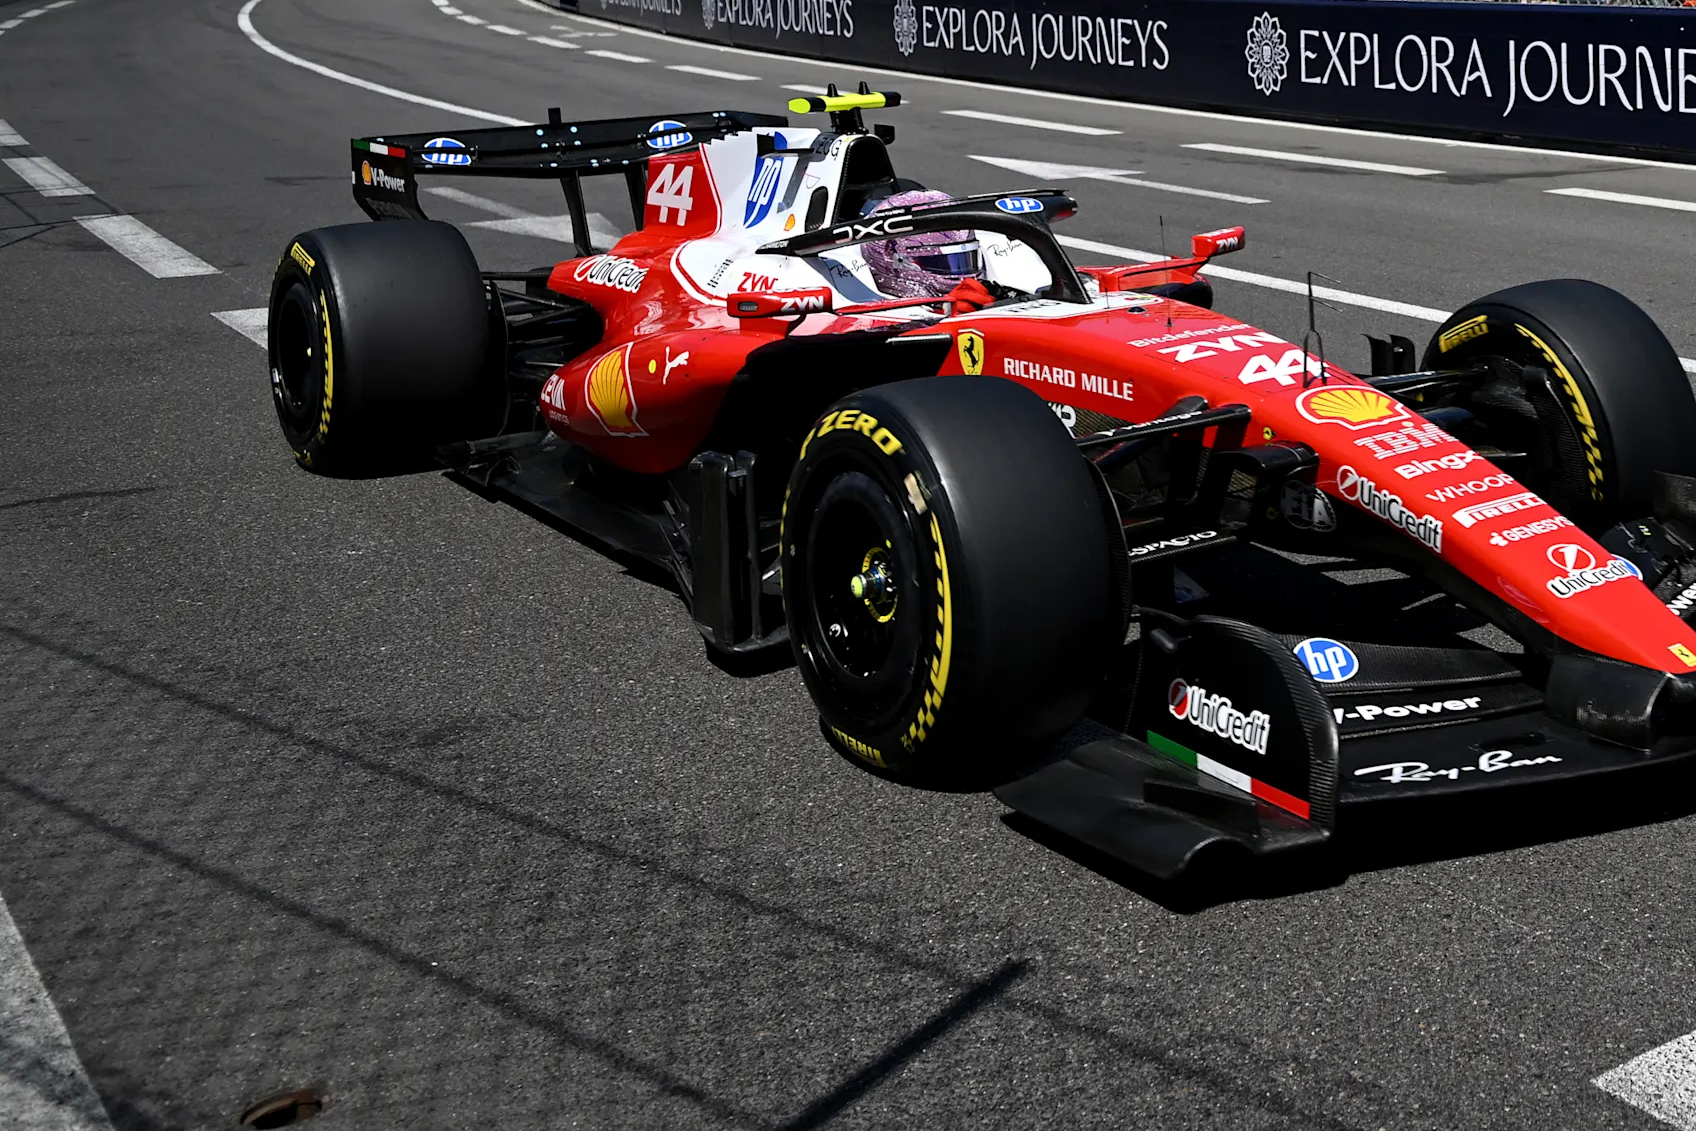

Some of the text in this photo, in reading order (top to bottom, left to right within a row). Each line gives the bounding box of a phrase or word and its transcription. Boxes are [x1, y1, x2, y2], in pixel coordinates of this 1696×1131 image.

[921, 5, 1171, 71] EXPLORA JOURNEYS
[1300, 29, 1493, 98] EXPLORA
[370, 167, 405, 193] V-Power
[647, 163, 694, 226] 44
[1004, 198, 1039, 213] hp
[1215, 236, 1239, 251] ZYN
[737, 271, 779, 292] ZYN
[781, 295, 824, 311] ZYN
[1127, 323, 1252, 348] Bitdefender
[1156, 331, 1289, 363] ZYN
[1438, 314, 1490, 354] PIRELLI
[1003, 357, 1134, 402] RICHARD MILLE
[1237, 348, 1331, 387] 44
[816, 409, 903, 457] ZERO
[1353, 422, 1460, 461] IBM
[1424, 472, 1516, 503] WHOOP
[1359, 477, 1443, 552] UniCredit
[1501, 515, 1575, 542] GENESYS
[1302, 639, 1348, 683] hp
[1189, 687, 1269, 752] UniCredit
[1353, 749, 1563, 784] Ray-Ban
